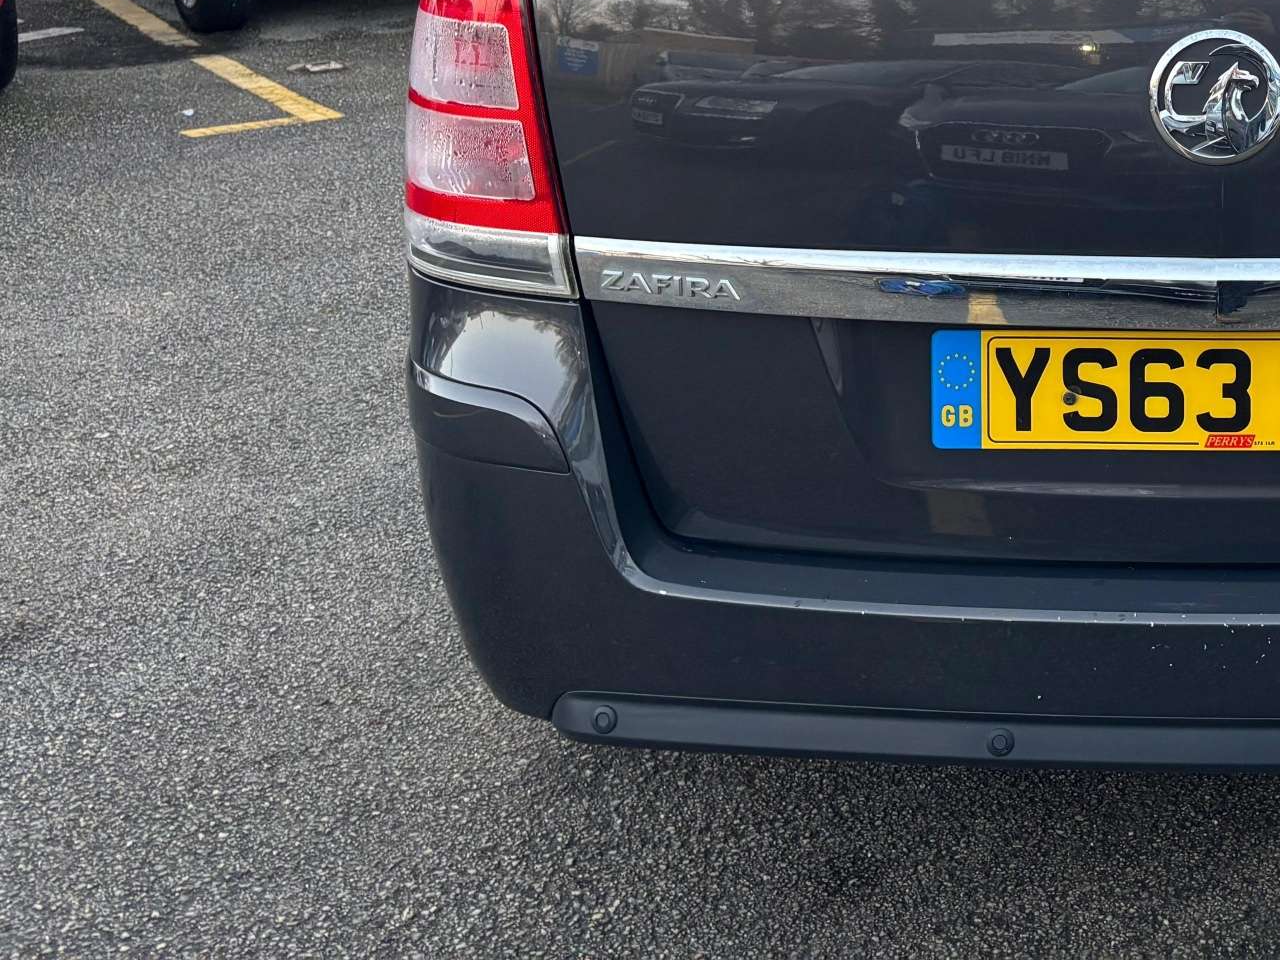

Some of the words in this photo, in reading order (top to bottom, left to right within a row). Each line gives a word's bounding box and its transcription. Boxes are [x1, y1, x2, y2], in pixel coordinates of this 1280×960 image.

[601, 270, 741, 301] ZAFIRA
[995, 347, 1253, 433] YS63
[941, 404, 974, 428] GB
[1206, 435, 1254, 447] PERRYS
